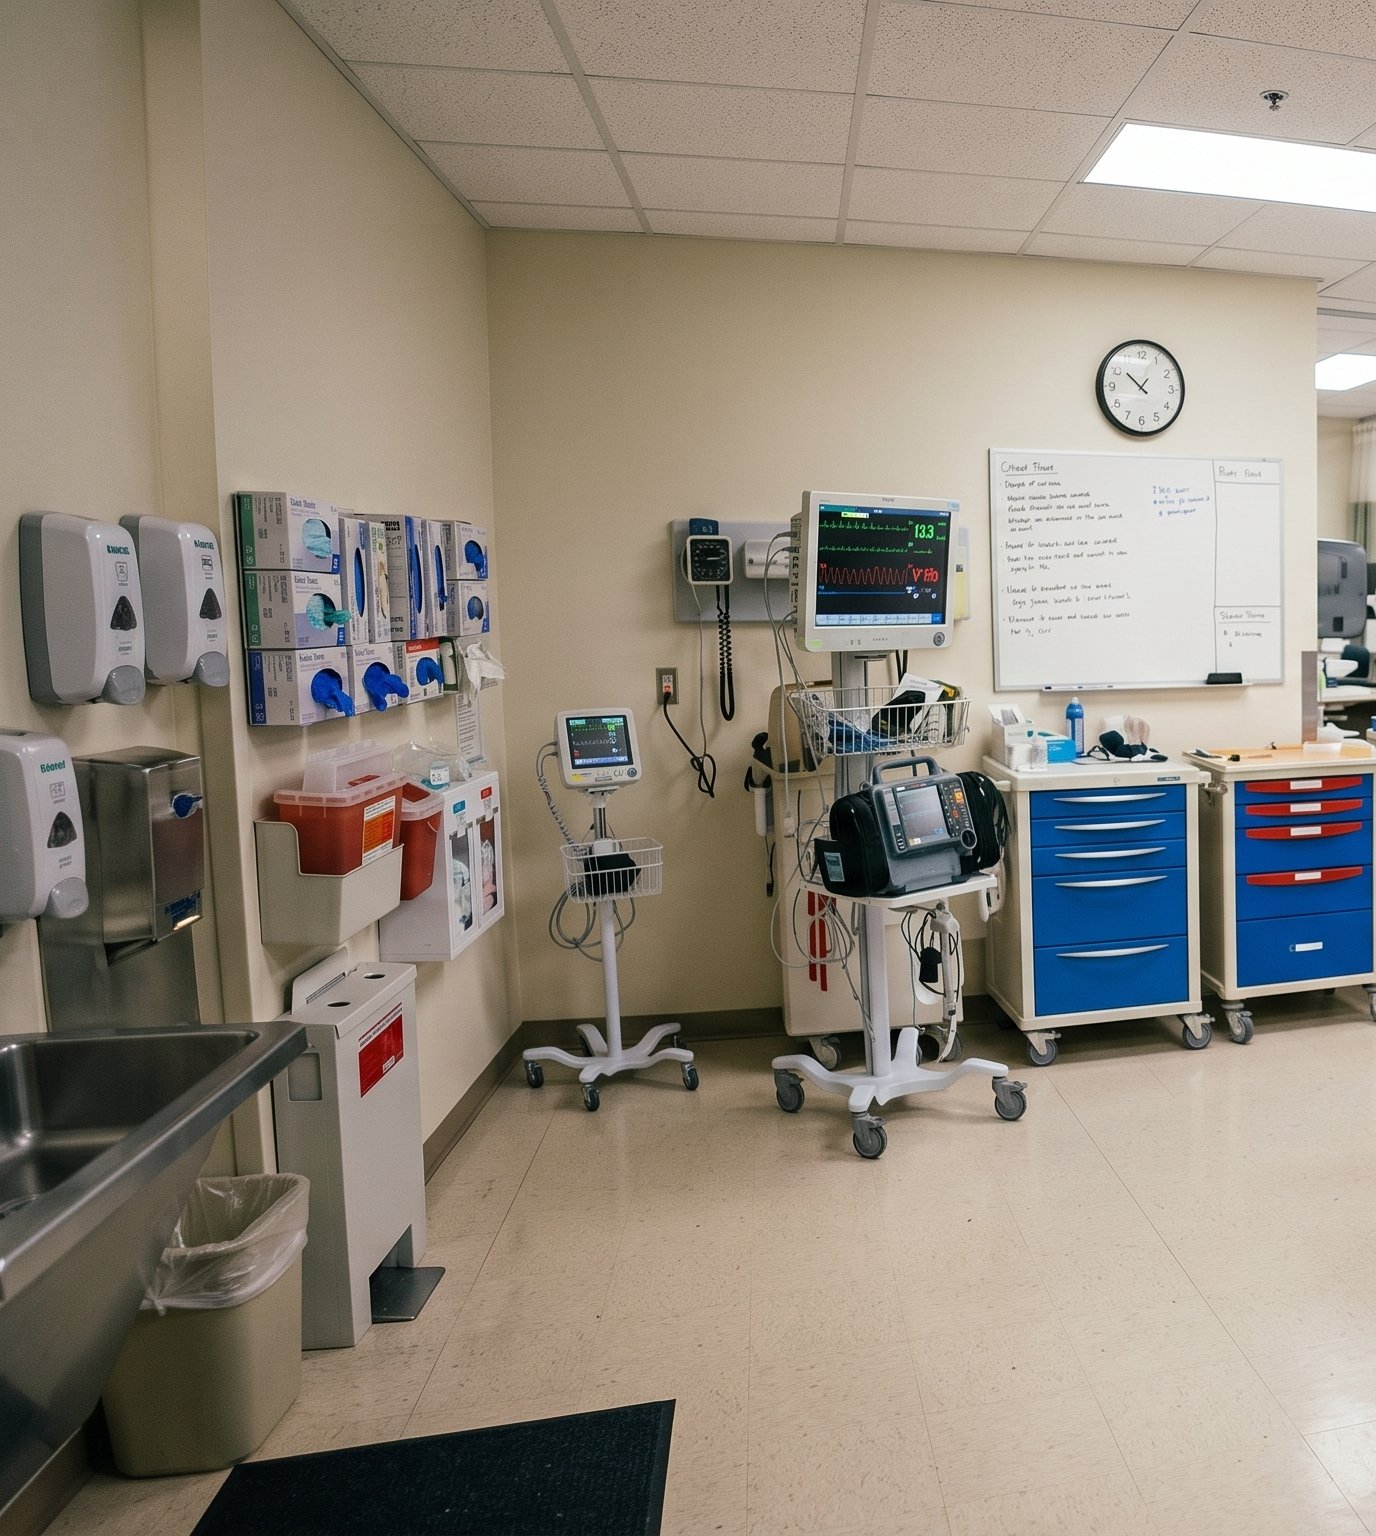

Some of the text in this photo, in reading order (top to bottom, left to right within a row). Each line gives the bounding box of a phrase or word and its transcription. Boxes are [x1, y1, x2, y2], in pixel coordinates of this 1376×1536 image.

[1137, 350, 1147, 360] 12
[1163, 370, 1170, 379] 2
[1108, 382, 1115, 391] 9
[1168, 385, 1175, 394] 3
[1163, 402, 1170, 410] 4
[1124, 411, 1131, 420] 7
[1153, 412, 1160, 422] 5
[1138, 416, 1145, 425] 6
[914, 523, 935, 539] 13.3
